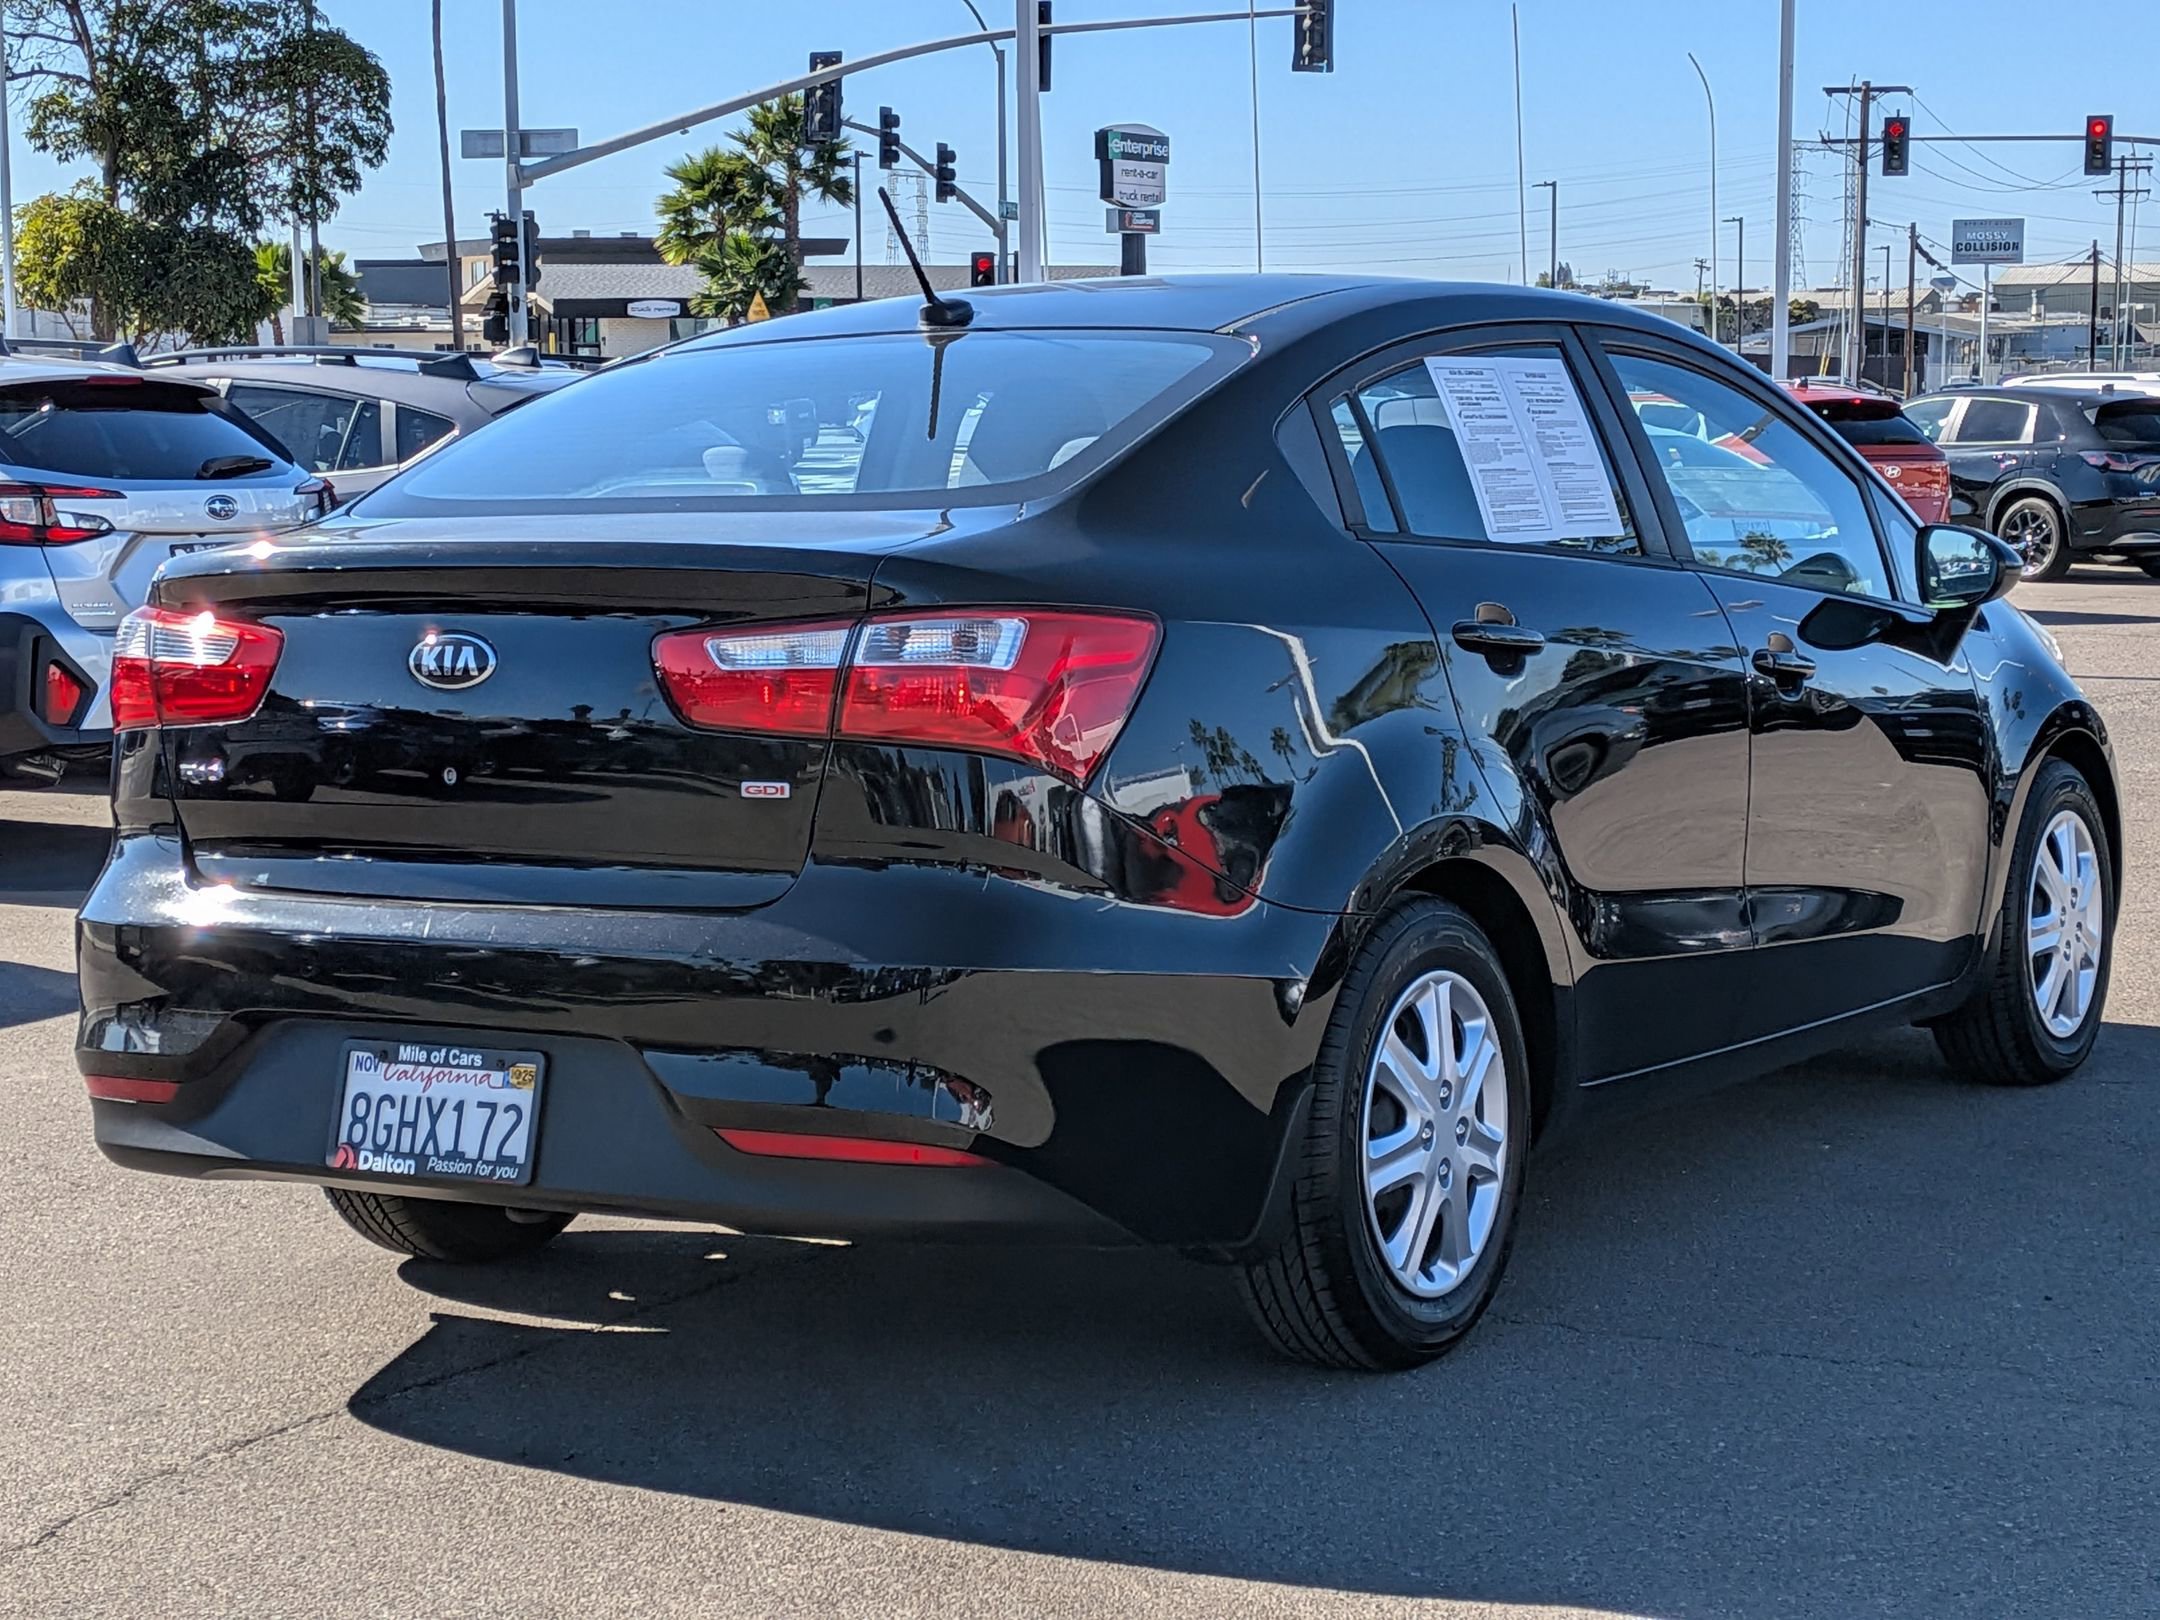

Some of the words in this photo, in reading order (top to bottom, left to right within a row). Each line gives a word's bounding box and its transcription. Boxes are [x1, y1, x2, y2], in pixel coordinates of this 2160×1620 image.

[1109, 138, 1168, 158] enterprise
[1121, 168, 1158, 179] rent-a-car
[1119, 189, 1138, 201] truck
[1141, 191, 1162, 203] rental
[1966, 231, 2008, 241] MOSSY
[1956, 241, 2019, 253] COLLISION
[421, 645, 479, 676] KIA
[744, 785, 785, 796] GDI
[355, 1055, 380, 1073] NOV
[398, 1046, 427, 1063] Mile
[430, 1048, 445, 1064] of
[448, 1050, 483, 1067] Cars
[347, 1092, 523, 1162] 8GHX172
[358, 1150, 416, 1175] Dalton
[427, 1156, 471, 1175] Passion
[474, 1160, 493, 1177] for
[492, 1165, 519, 1180] you
